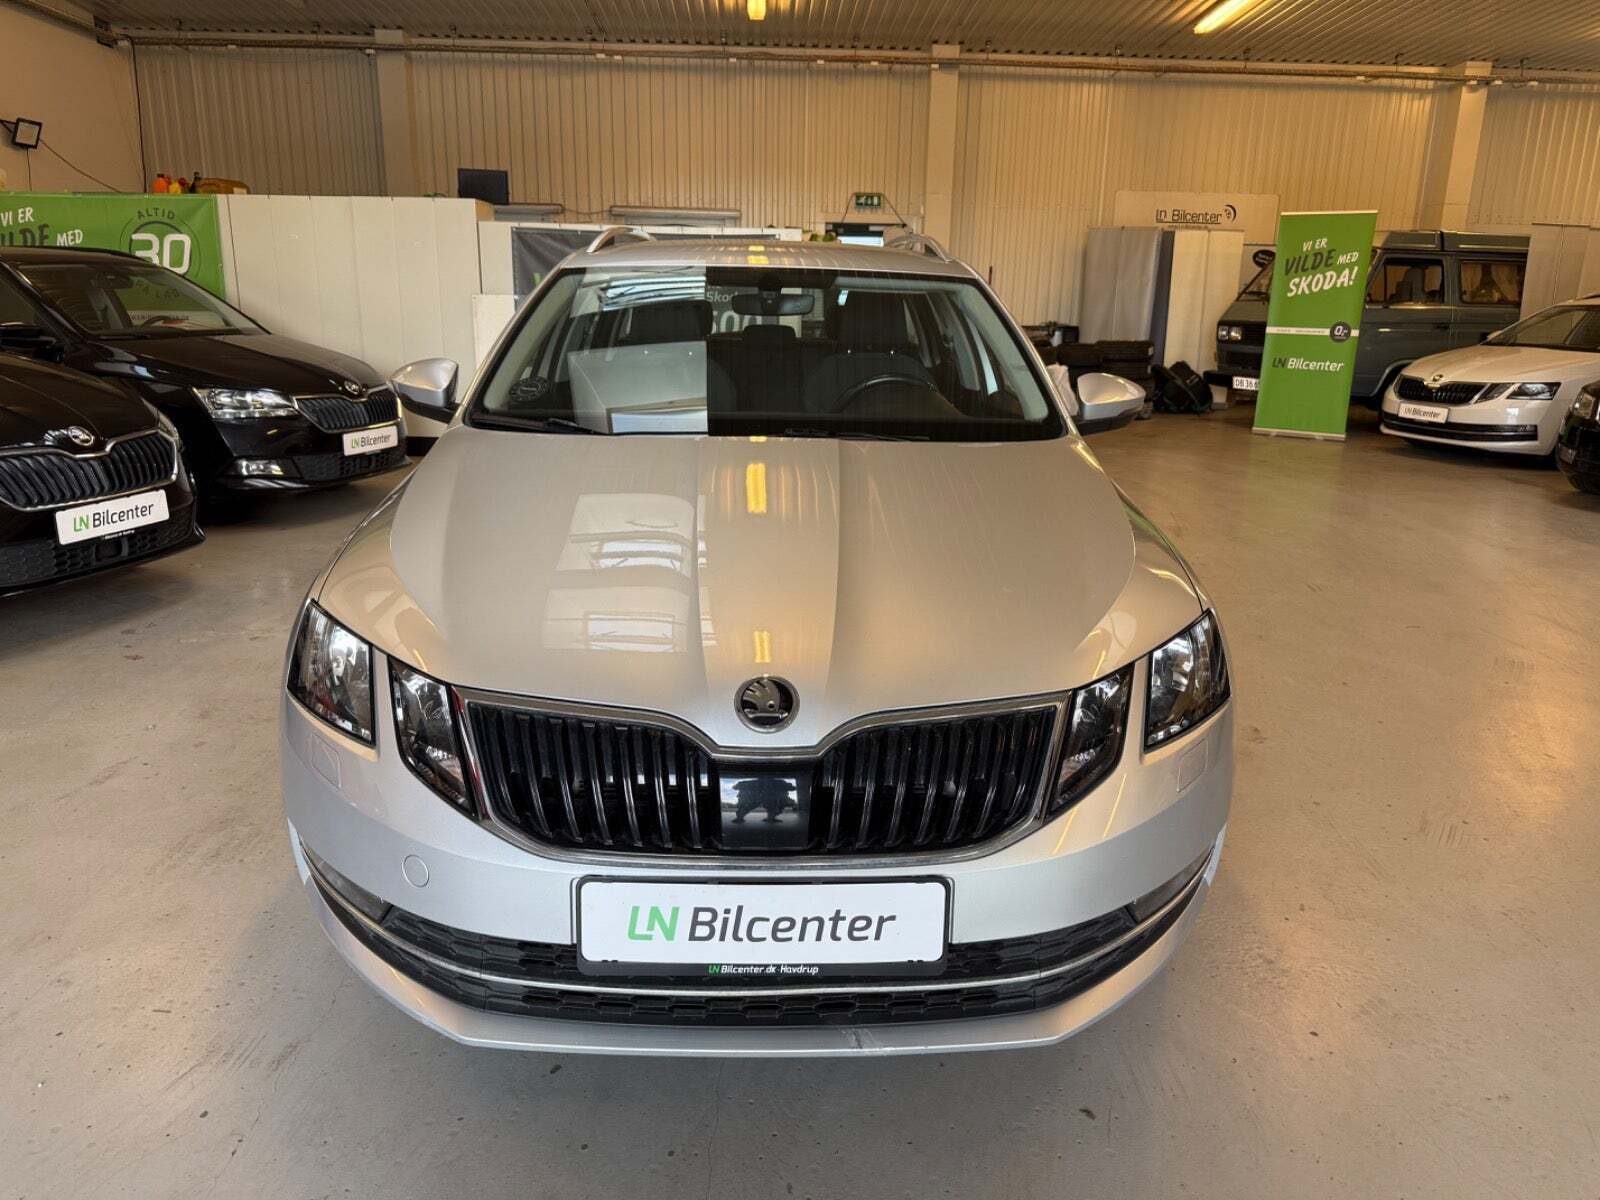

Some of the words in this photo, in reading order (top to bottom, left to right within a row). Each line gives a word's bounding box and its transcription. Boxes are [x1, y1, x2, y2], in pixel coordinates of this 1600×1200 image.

[1, 210, 12, 226] VI
[18, 207, 34, 223] ER
[137, 207, 176, 220] ALTID
[1172, 209, 1222, 223] Bilcenter
[56, 229, 83, 246] MED
[1303, 240, 1313, 252] VI
[1315, 237, 1328, 249] ER
[132, 232, 191, 275] 30
[1284, 249, 1336, 276] VILDE
[1337, 251, 1359, 265] MED
[1287, 266, 1358, 297] SKODA!
[1287, 358, 1344, 371] Bilcenter
[360, 434, 391, 448] Bilcenter
[73, 515, 90, 532] LN
[92, 503, 154, 528] Bilcenter
[627, 905, 680, 942] LN
[688, 906, 897, 943] Bilcenter
[780, 965, 819, 976] Havdrup
